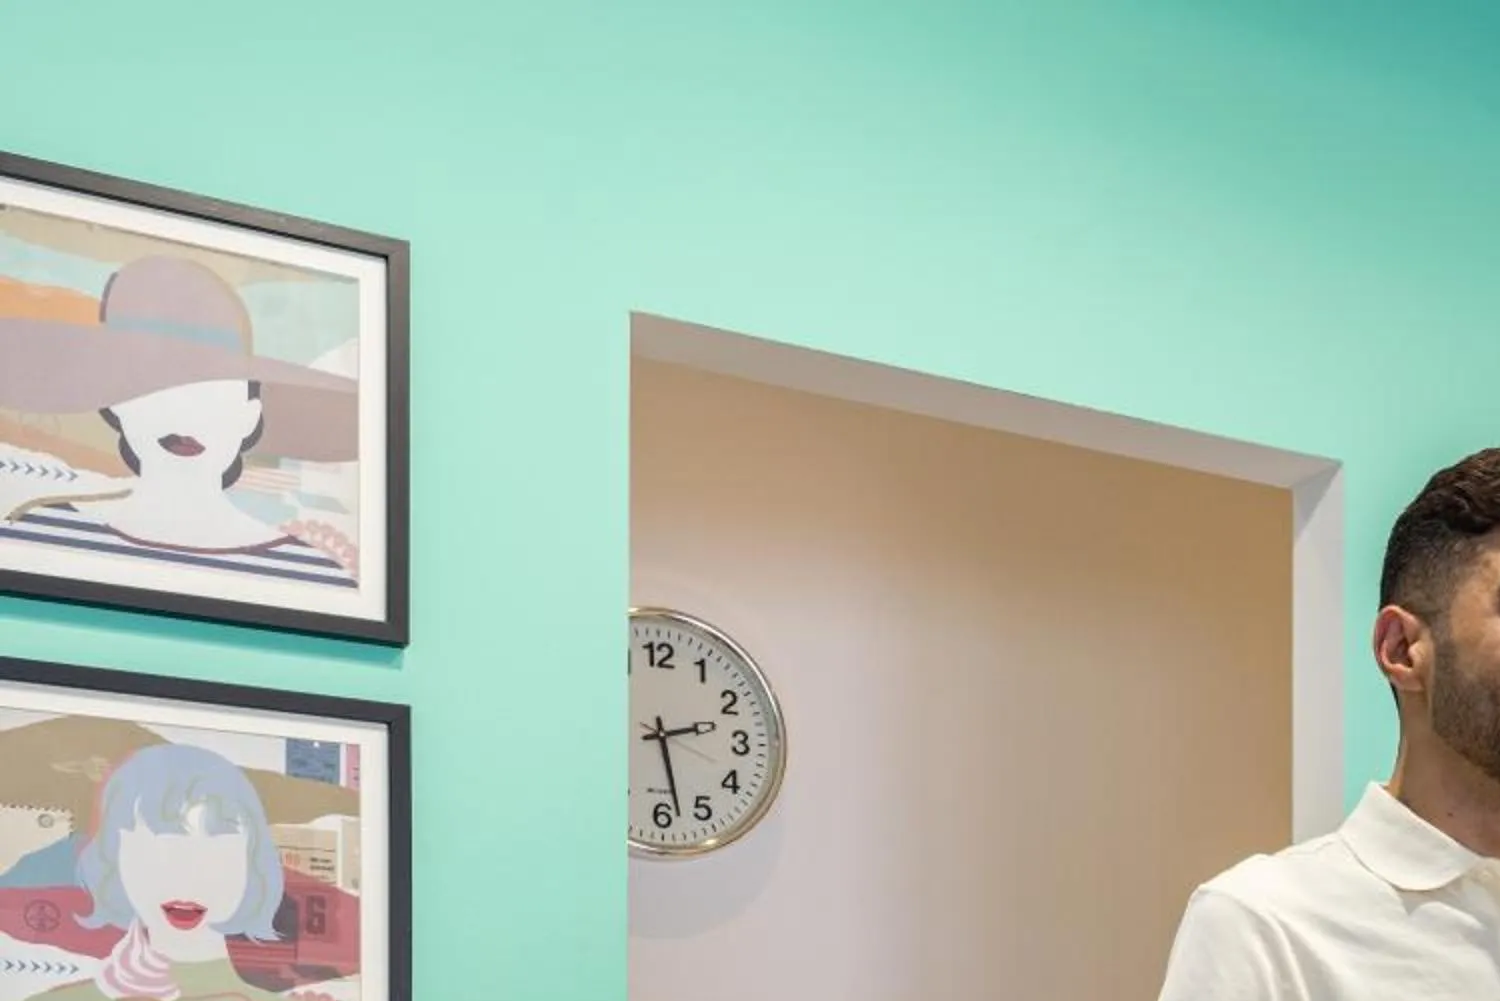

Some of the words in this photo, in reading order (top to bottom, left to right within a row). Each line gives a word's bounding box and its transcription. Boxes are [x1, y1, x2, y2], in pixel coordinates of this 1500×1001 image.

[642, 642, 676, 670] 12
[693, 658, 707, 684] 1
[720, 689, 739, 716] 2
[731, 729, 751, 757] 3
[721, 769, 741, 795] 4
[652, 802, 673, 829] 6
[693, 795, 713, 822] 5
